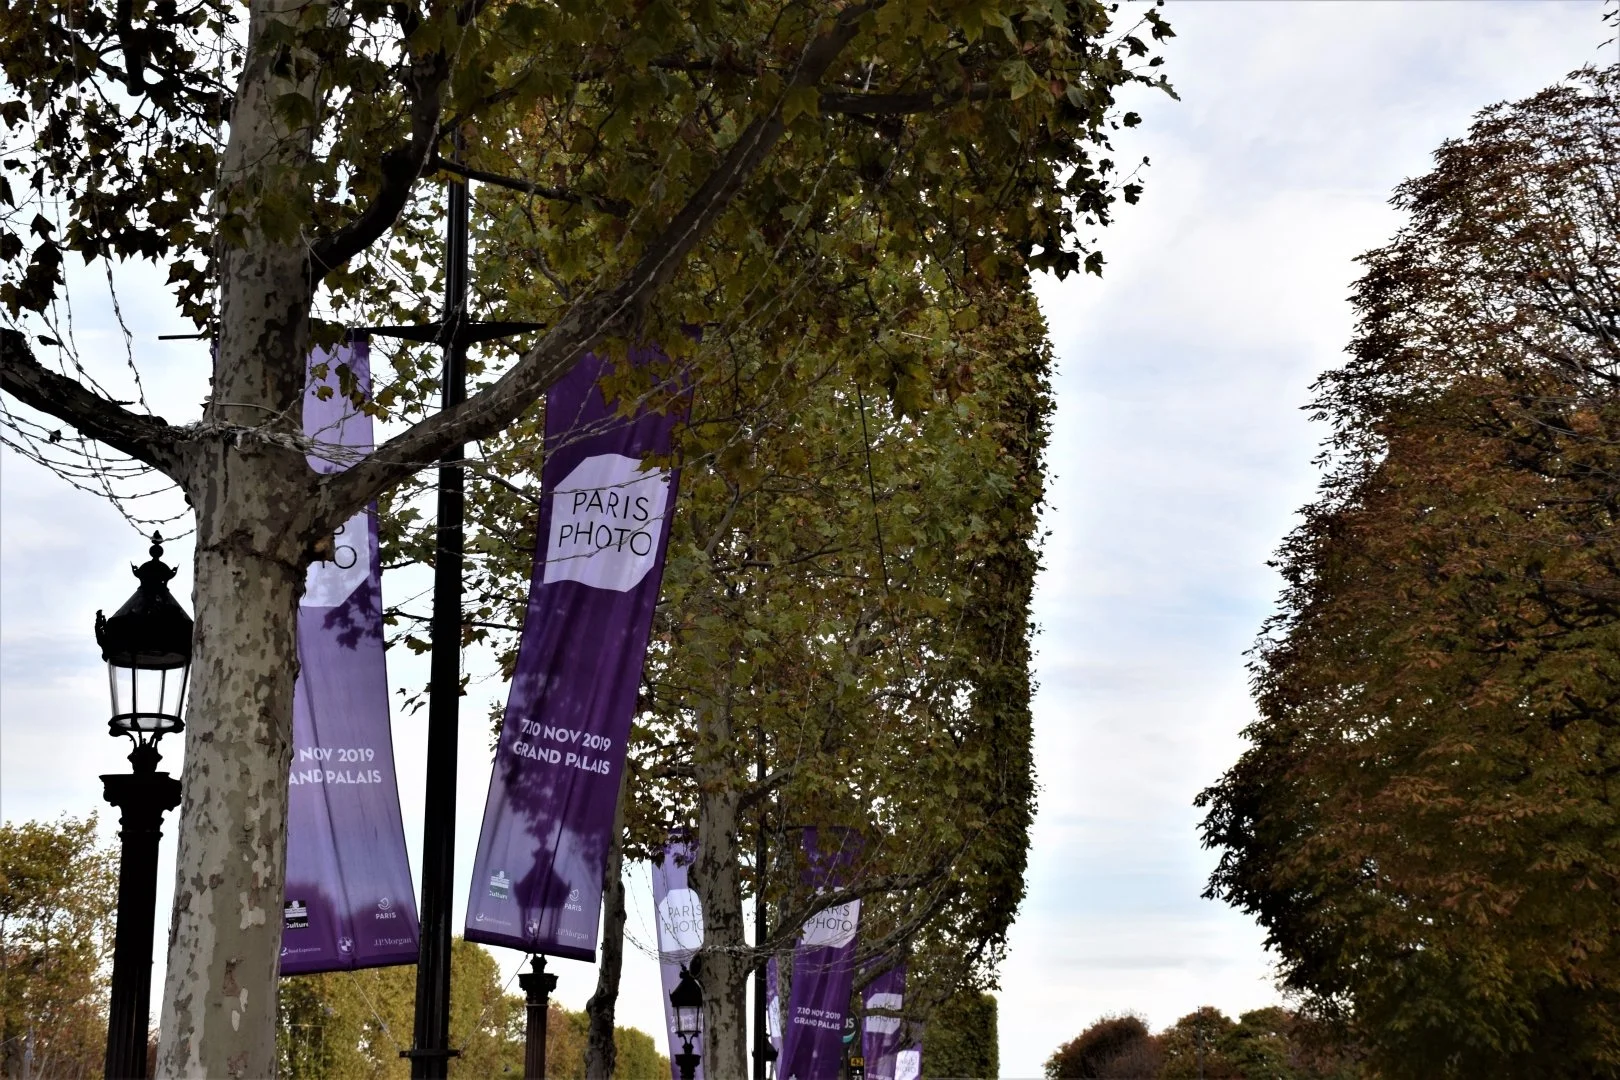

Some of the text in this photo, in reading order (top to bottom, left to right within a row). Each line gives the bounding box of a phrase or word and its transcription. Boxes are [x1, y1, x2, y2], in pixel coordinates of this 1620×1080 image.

[573, 490, 649, 521] PARIS
[559, 521, 652, 556] PHOTO
[543, 725, 582, 744] NOV
[582, 733, 612, 752] 2019
[300, 747, 375, 762] NOV 2019
[513, 741, 611, 775] GRAND PALAIS
[289, 769, 382, 785] AND PALAIS
[564, 901, 582, 912] PARIS
[819, 904, 850, 917] ARIS
[375, 911, 397, 921] PARIS
[807, 917, 853, 932] PHOTO
[811, 1010, 825, 1018] NOV
[793, 1016, 818, 1027] GRAND
[817, 1020, 841, 1031] PALAIS
